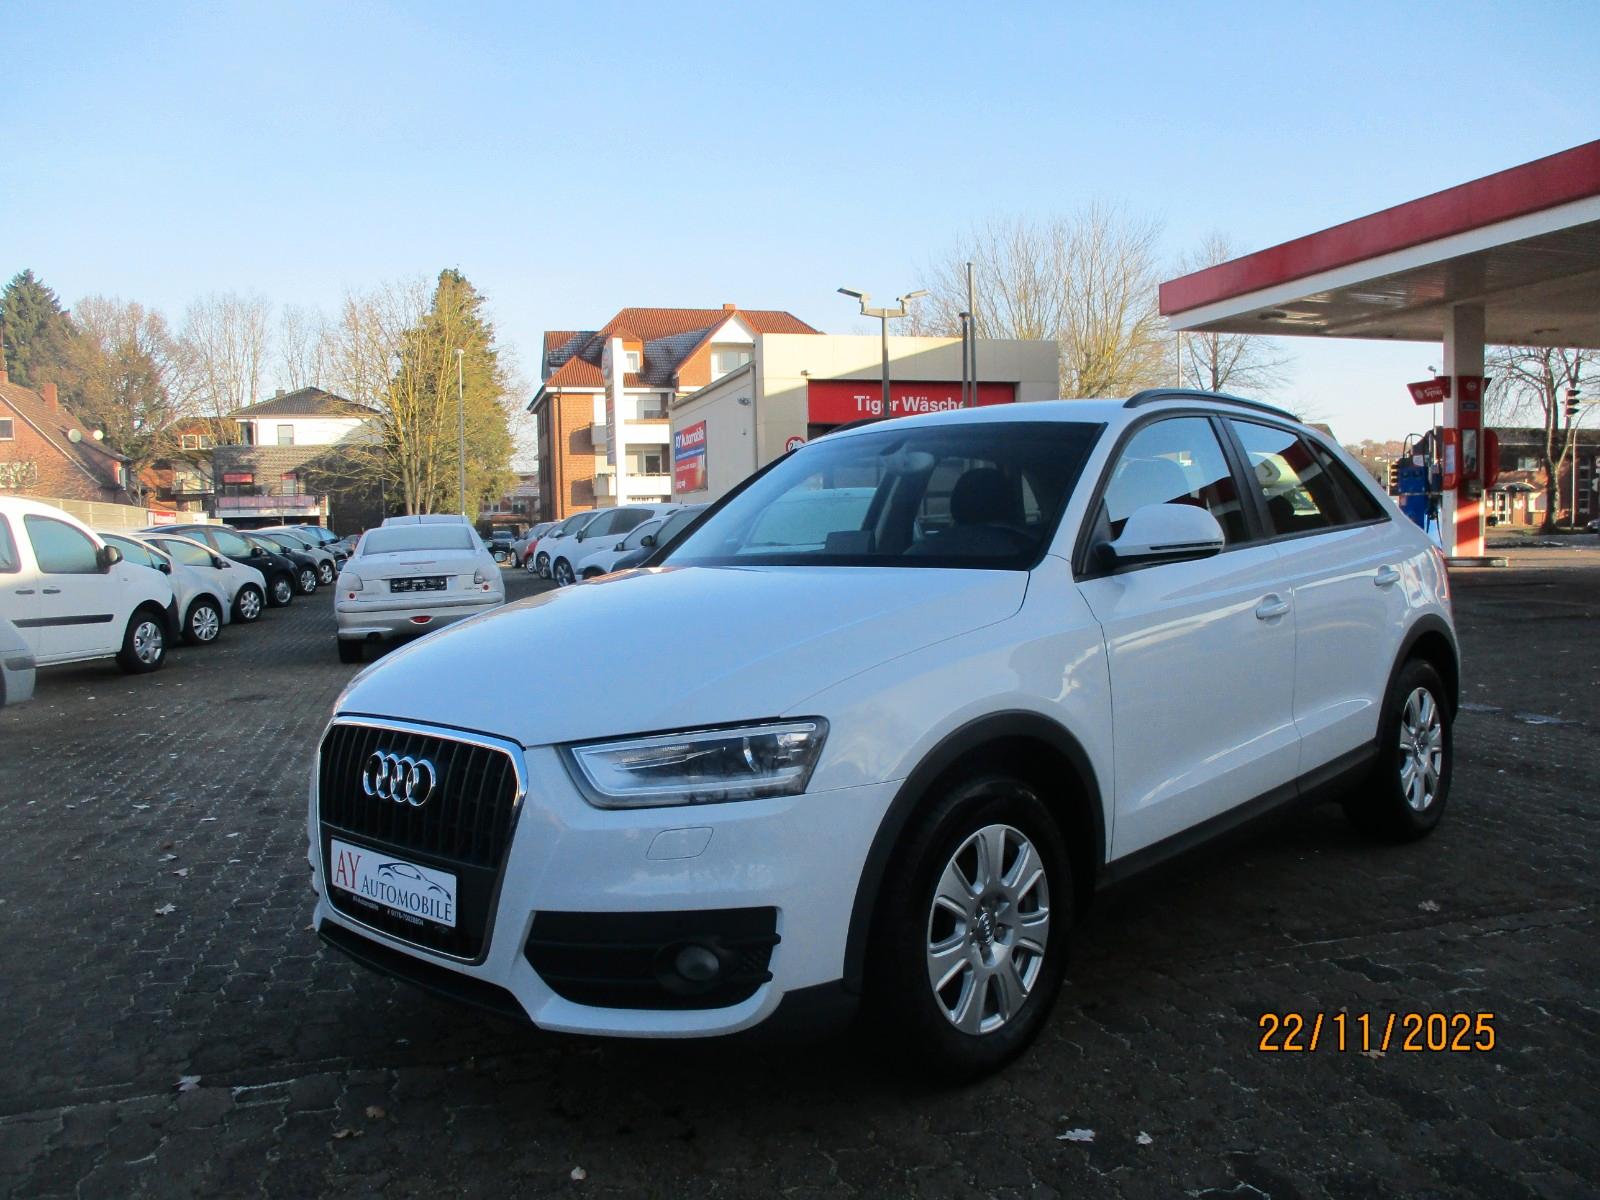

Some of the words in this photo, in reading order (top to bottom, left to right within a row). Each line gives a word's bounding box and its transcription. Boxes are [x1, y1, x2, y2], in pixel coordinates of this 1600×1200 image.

[854, 395, 899, 414] Tigr
[335, 849, 362, 889] AY
[361, 874, 452, 922] AUTOMOBILE
